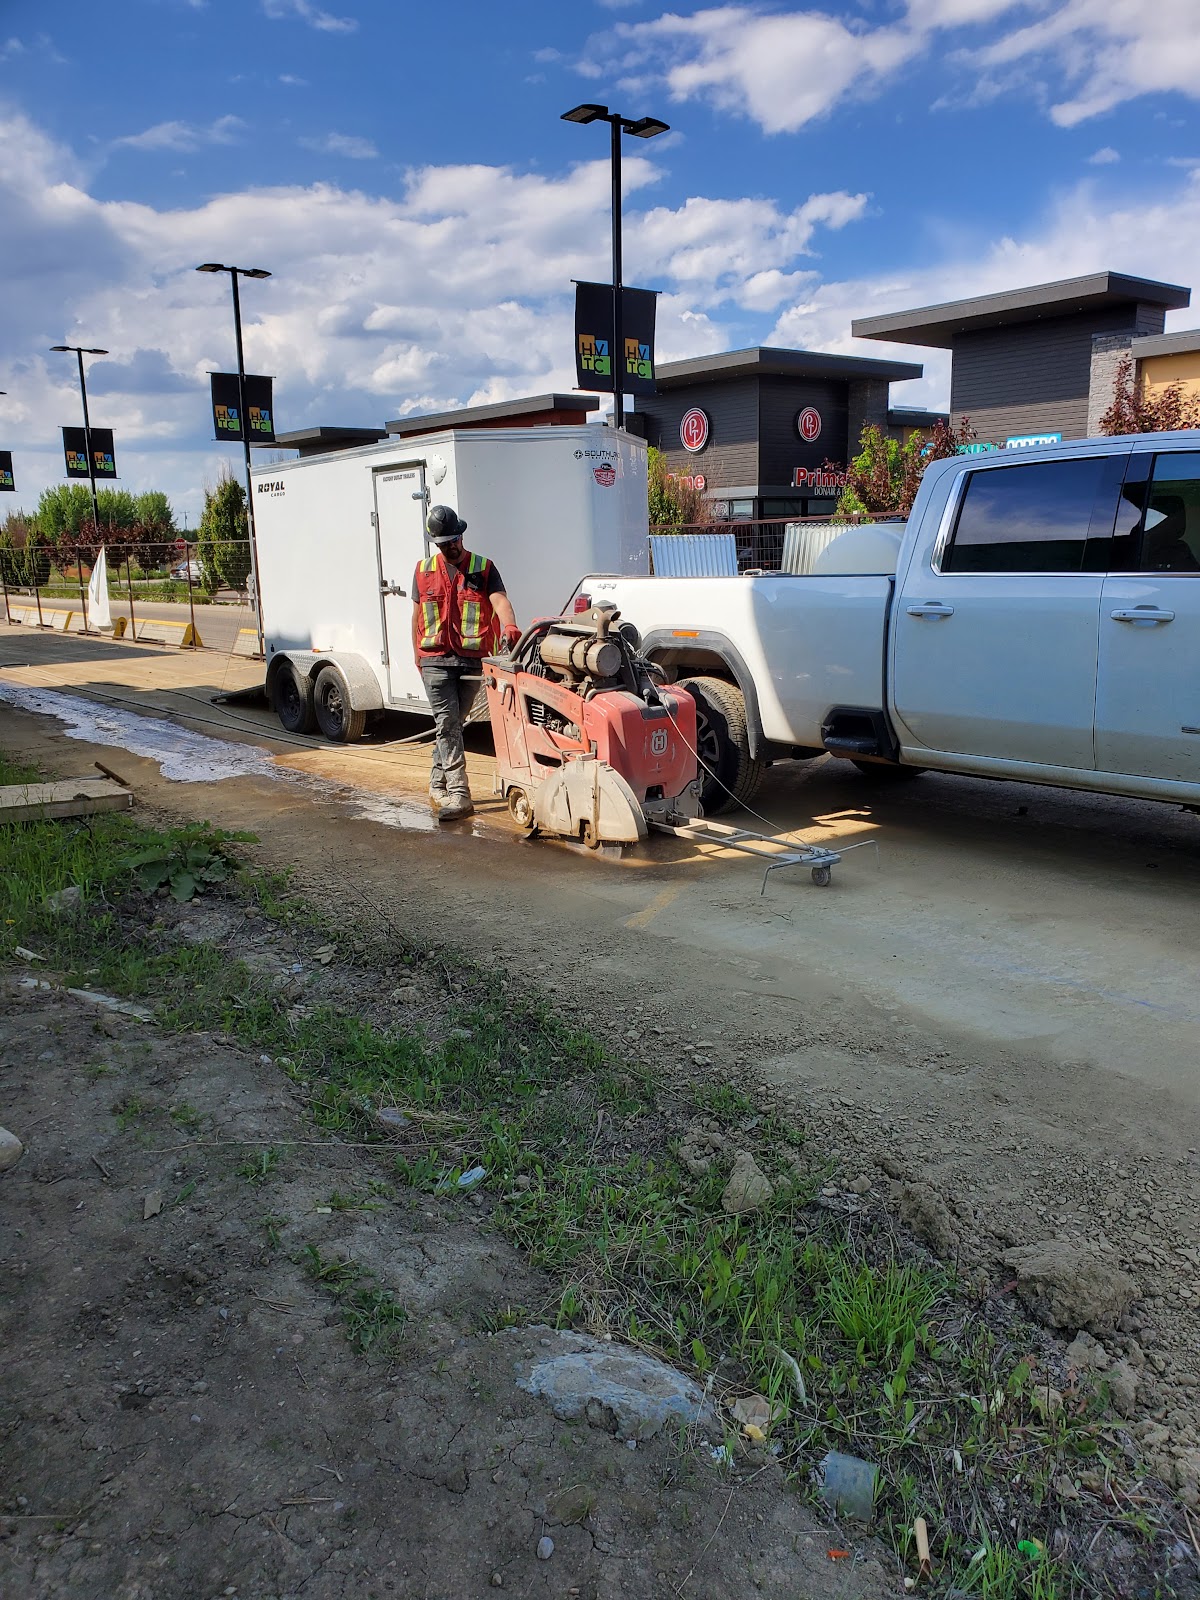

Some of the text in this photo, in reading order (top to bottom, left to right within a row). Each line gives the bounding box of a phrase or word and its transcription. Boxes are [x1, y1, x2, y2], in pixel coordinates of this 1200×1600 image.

[581, 342, 605, 357] HV
[627, 346, 647, 361] HV
[583, 358, 604, 373] TC
[629, 361, 647, 377] TC
[257, 480, 285, 493] ROYAL
[814, 486, 836, 496] DONAIR
